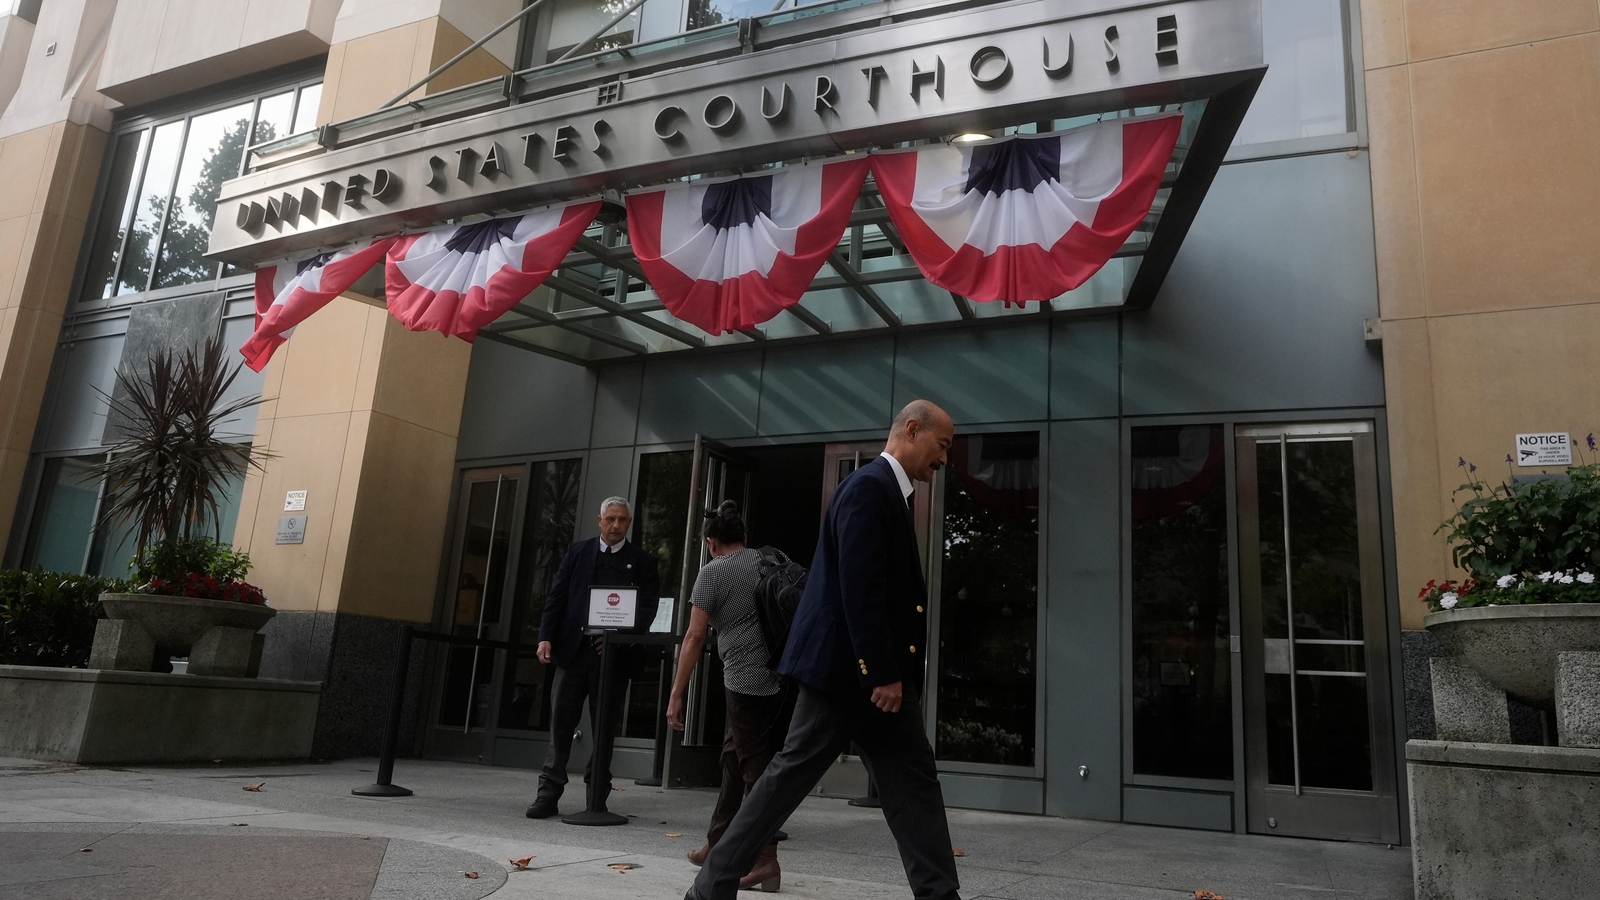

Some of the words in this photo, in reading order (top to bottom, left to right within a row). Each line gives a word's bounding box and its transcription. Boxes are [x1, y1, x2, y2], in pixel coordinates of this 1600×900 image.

[236, 168, 399, 237] UNITED
[425, 118, 613, 193] STATES
[652, 14, 1179, 144] COURTHOUSE
[1519, 435, 1566, 446] NOTICE
